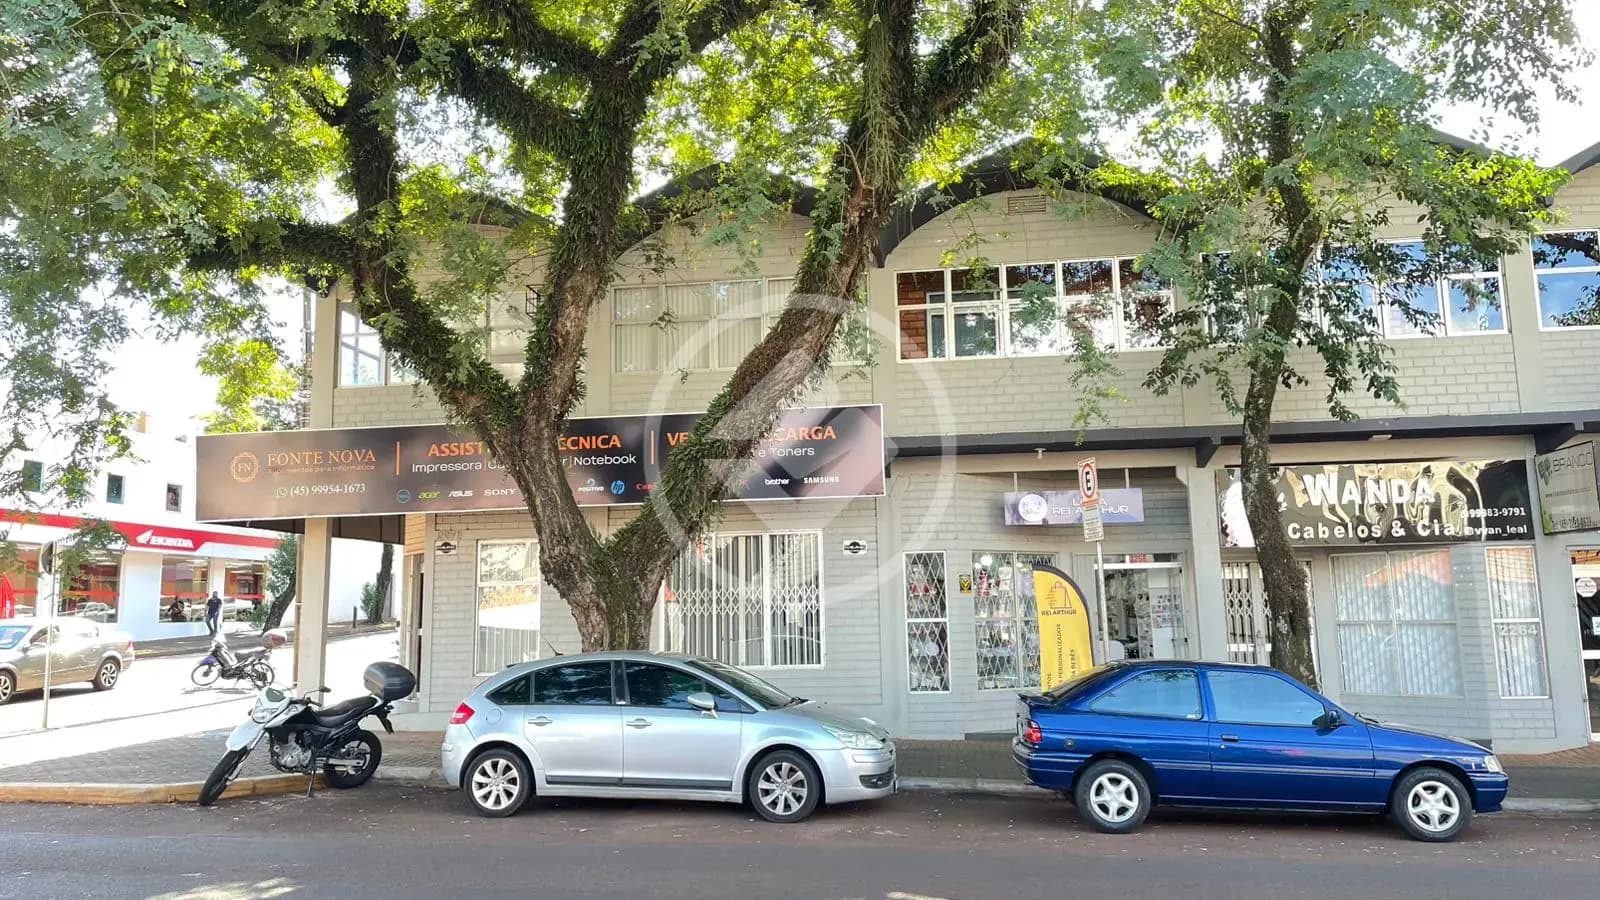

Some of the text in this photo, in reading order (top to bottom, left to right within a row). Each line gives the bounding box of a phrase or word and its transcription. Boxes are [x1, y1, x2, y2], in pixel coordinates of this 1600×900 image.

[768, 425, 837, 441] CARGA
[428, 434, 621, 457] ASSIST ÉCNICA
[770, 447, 815, 457] Toners
[268, 449, 376, 466] FONTE NOVA
[574, 453, 637, 466] Notebook
[412, 461, 482, 474] Impressora
[765, 478, 789, 486] brother
[803, 476, 839, 484] SAMSUNG
[1086, 471, 1091, 491] E
[291, 483, 366, 497] (45) 99954-1673
[448, 490, 473, 498] ASUS
[484, 488, 516, 497] SONY
[1303, 473, 1434, 505] WANDA
[1053, 506, 1070, 515] REI
[1074, 504, 1128, 514] AHUR
[1288, 519, 1455, 539] Cabelos & Cia
